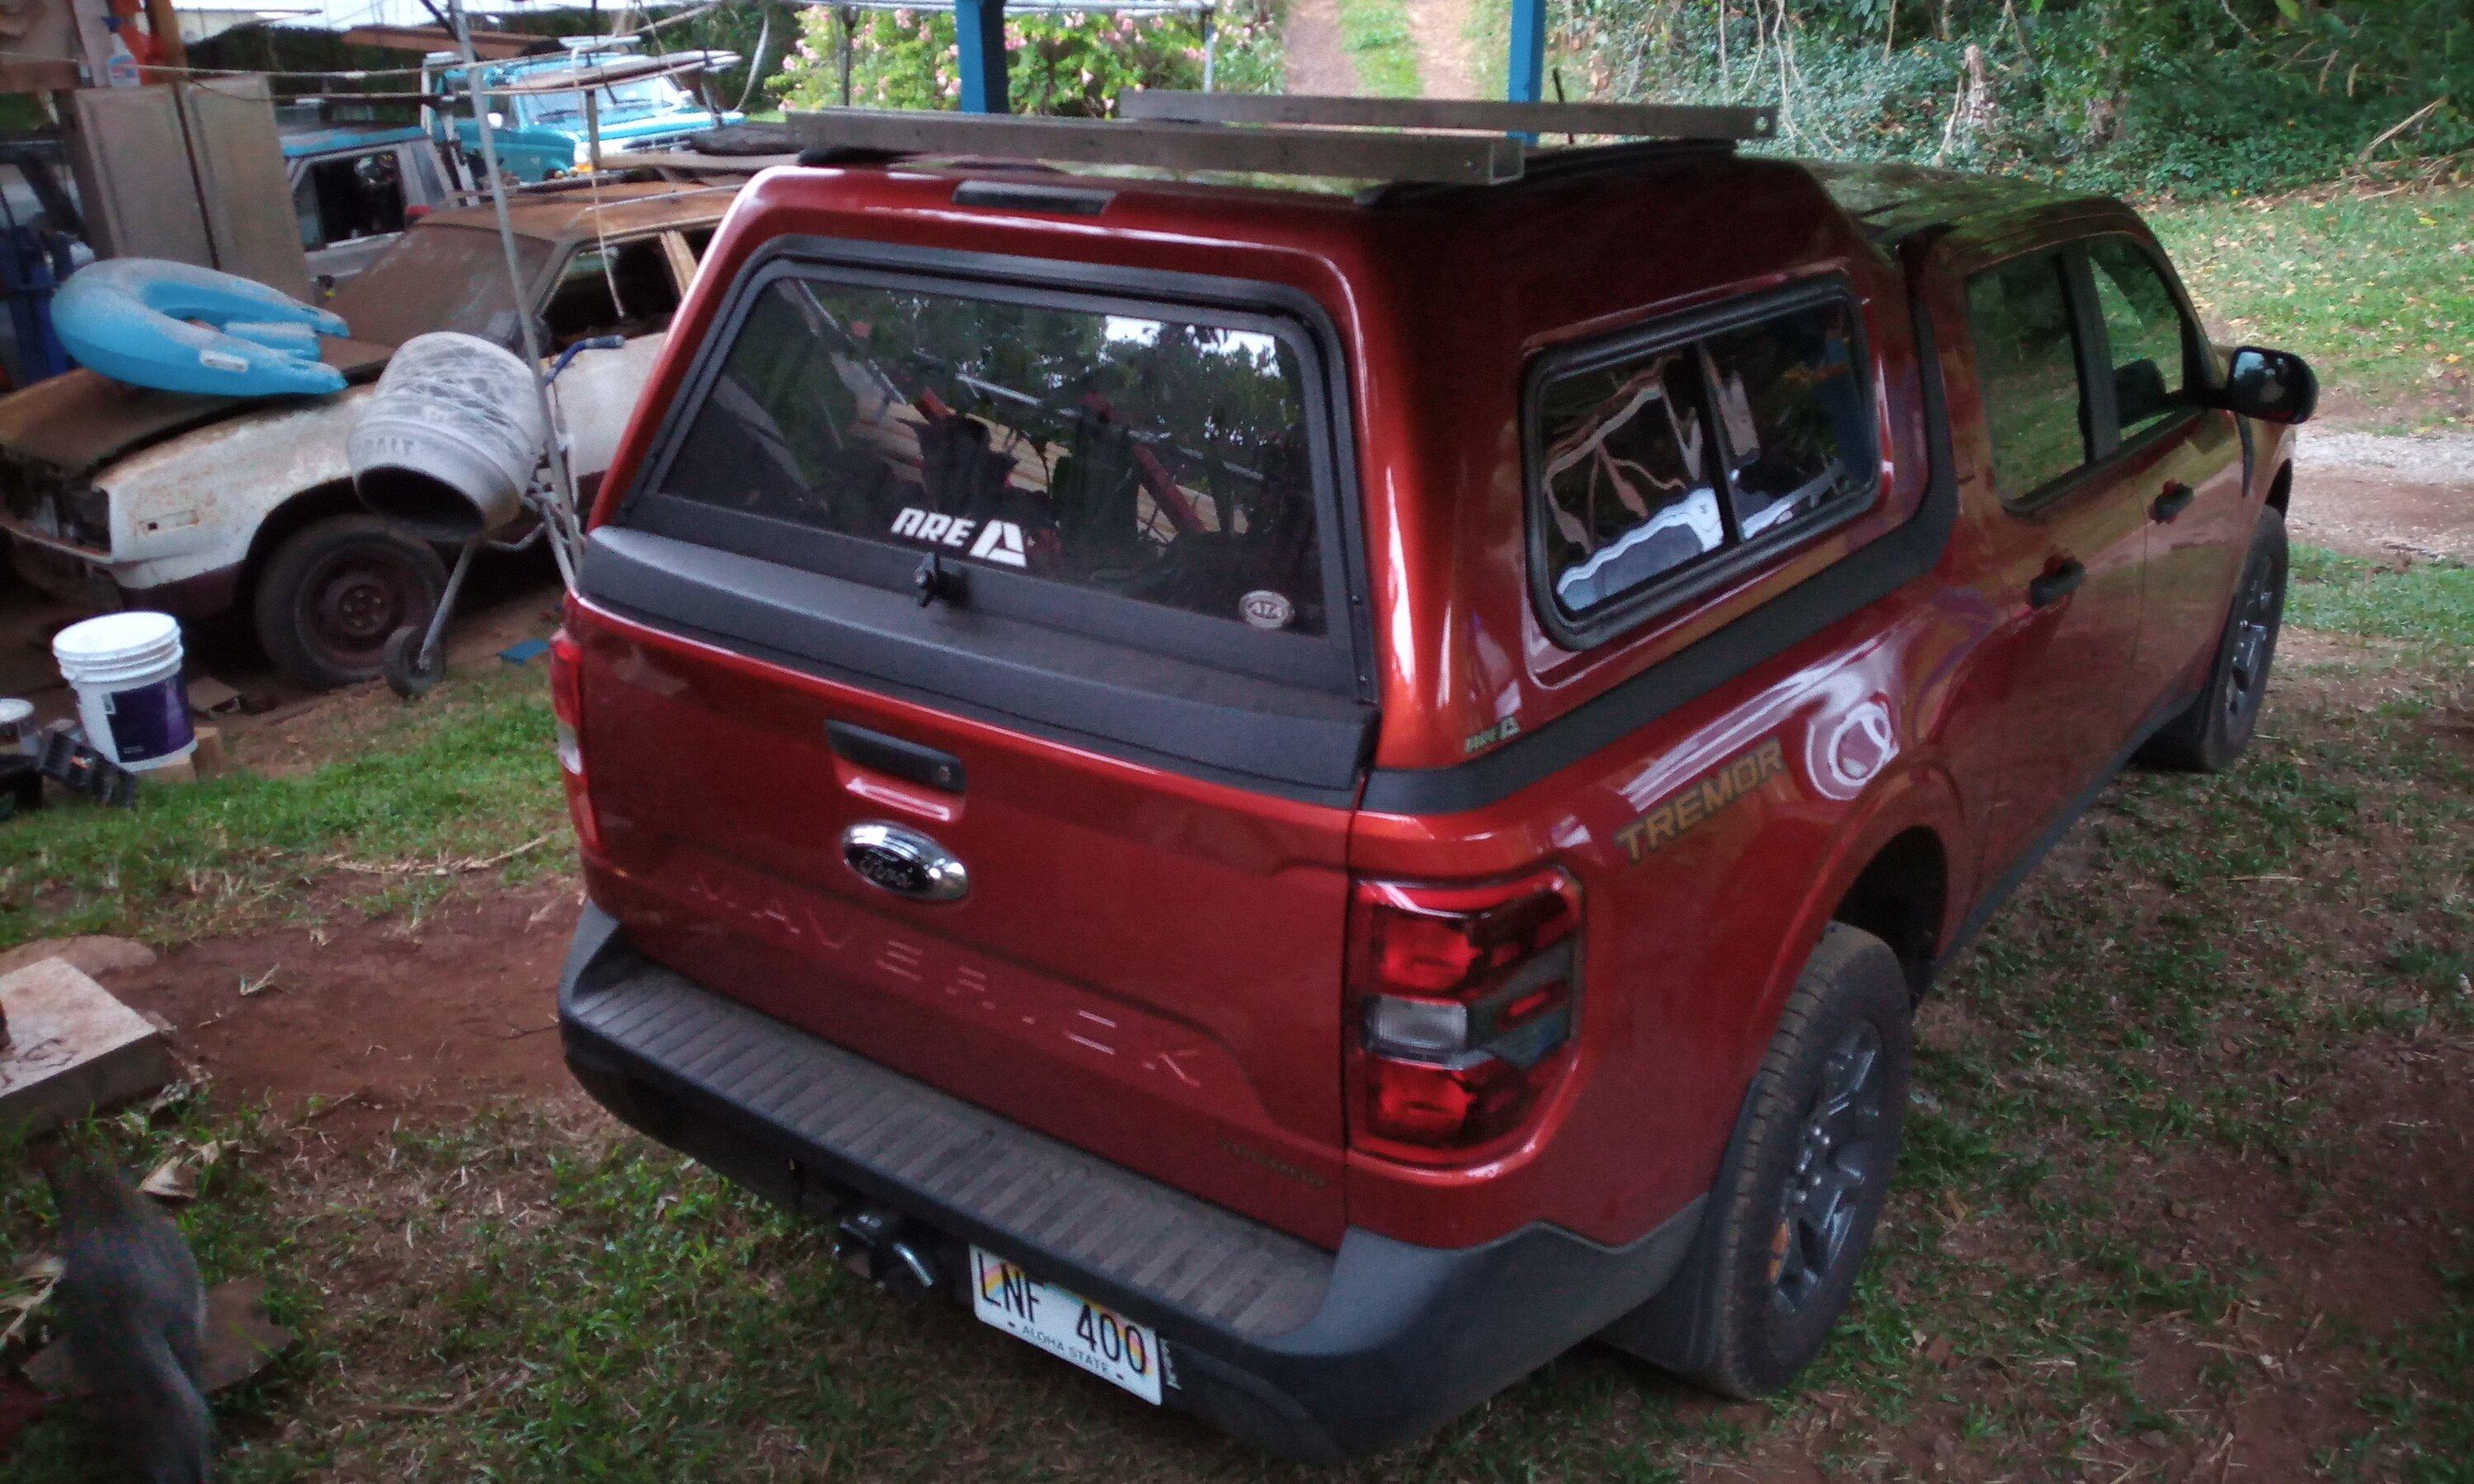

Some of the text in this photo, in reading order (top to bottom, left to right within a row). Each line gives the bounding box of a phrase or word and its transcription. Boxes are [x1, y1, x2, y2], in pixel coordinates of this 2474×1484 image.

[891, 507, 976, 547] ARE
[1611, 735, 1787, 866] TREMOR
[977, 1251, 1148, 1376] LNF 400
[1022, 1324, 1109, 1373] ALOHA STATE
